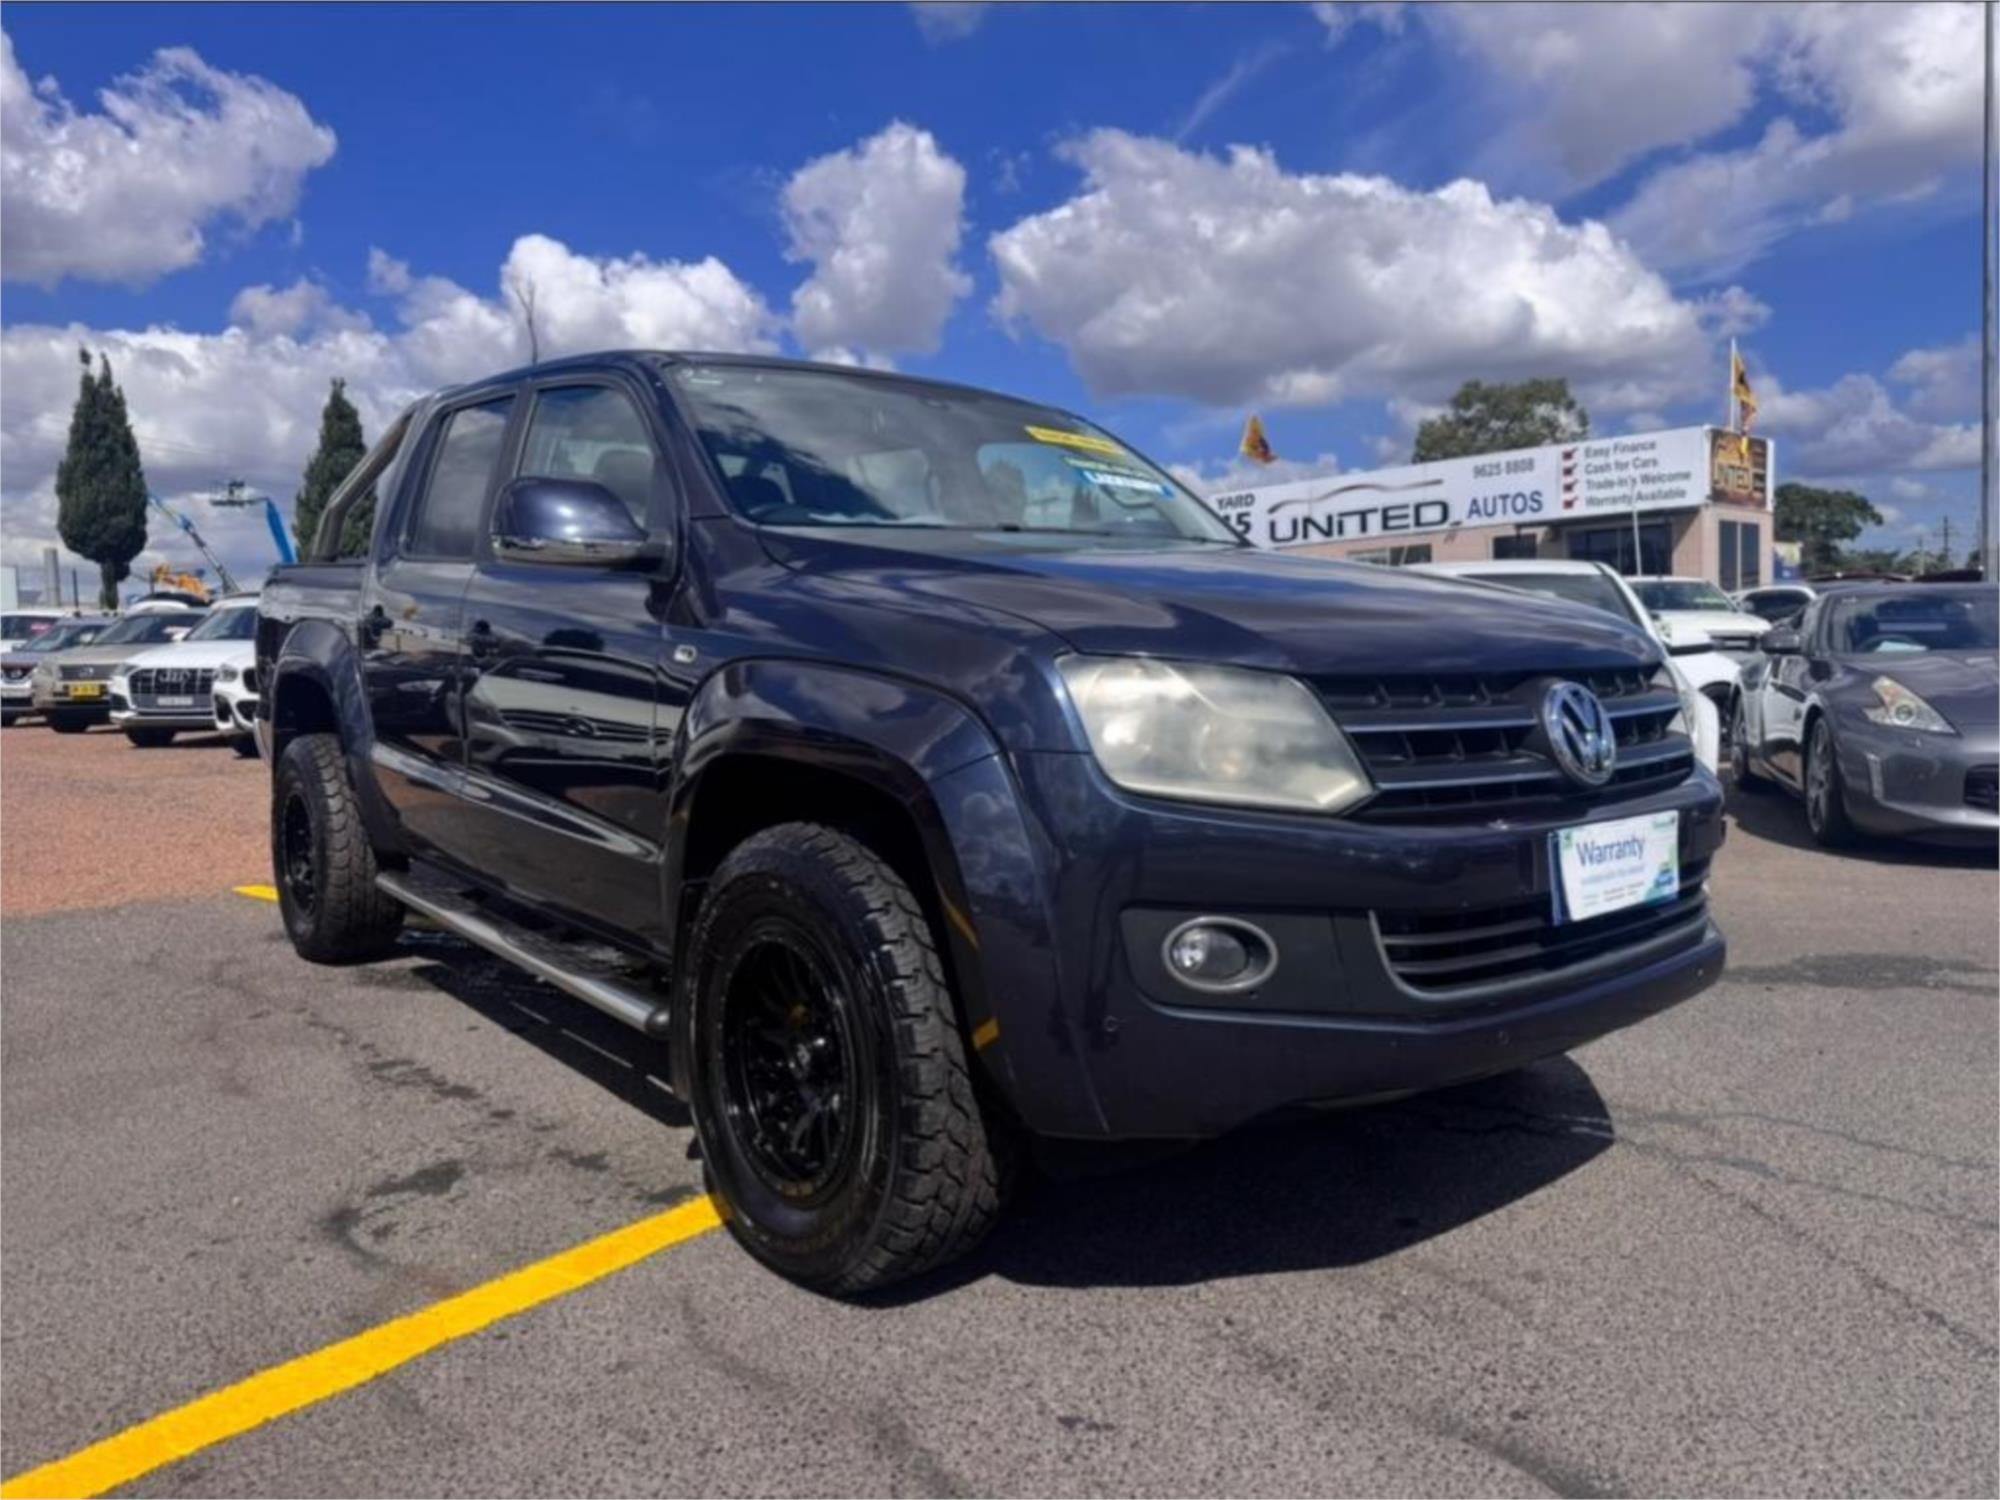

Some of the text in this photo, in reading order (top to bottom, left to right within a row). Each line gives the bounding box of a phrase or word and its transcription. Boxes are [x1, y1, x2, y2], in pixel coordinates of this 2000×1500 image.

[1584, 441, 1656, 458] Easy Finance
[1584, 456, 1658, 474] Cash for Cars
[1640, 471, 1692, 484] Welcome
[1216, 493, 1255, 510] YARD
[1467, 490, 1543, 519] AUTOS
[1585, 488, 1686, 506] Warranty Available
[1269, 500, 1449, 543] UNITED
[1576, 836, 1644, 867] Warranty
